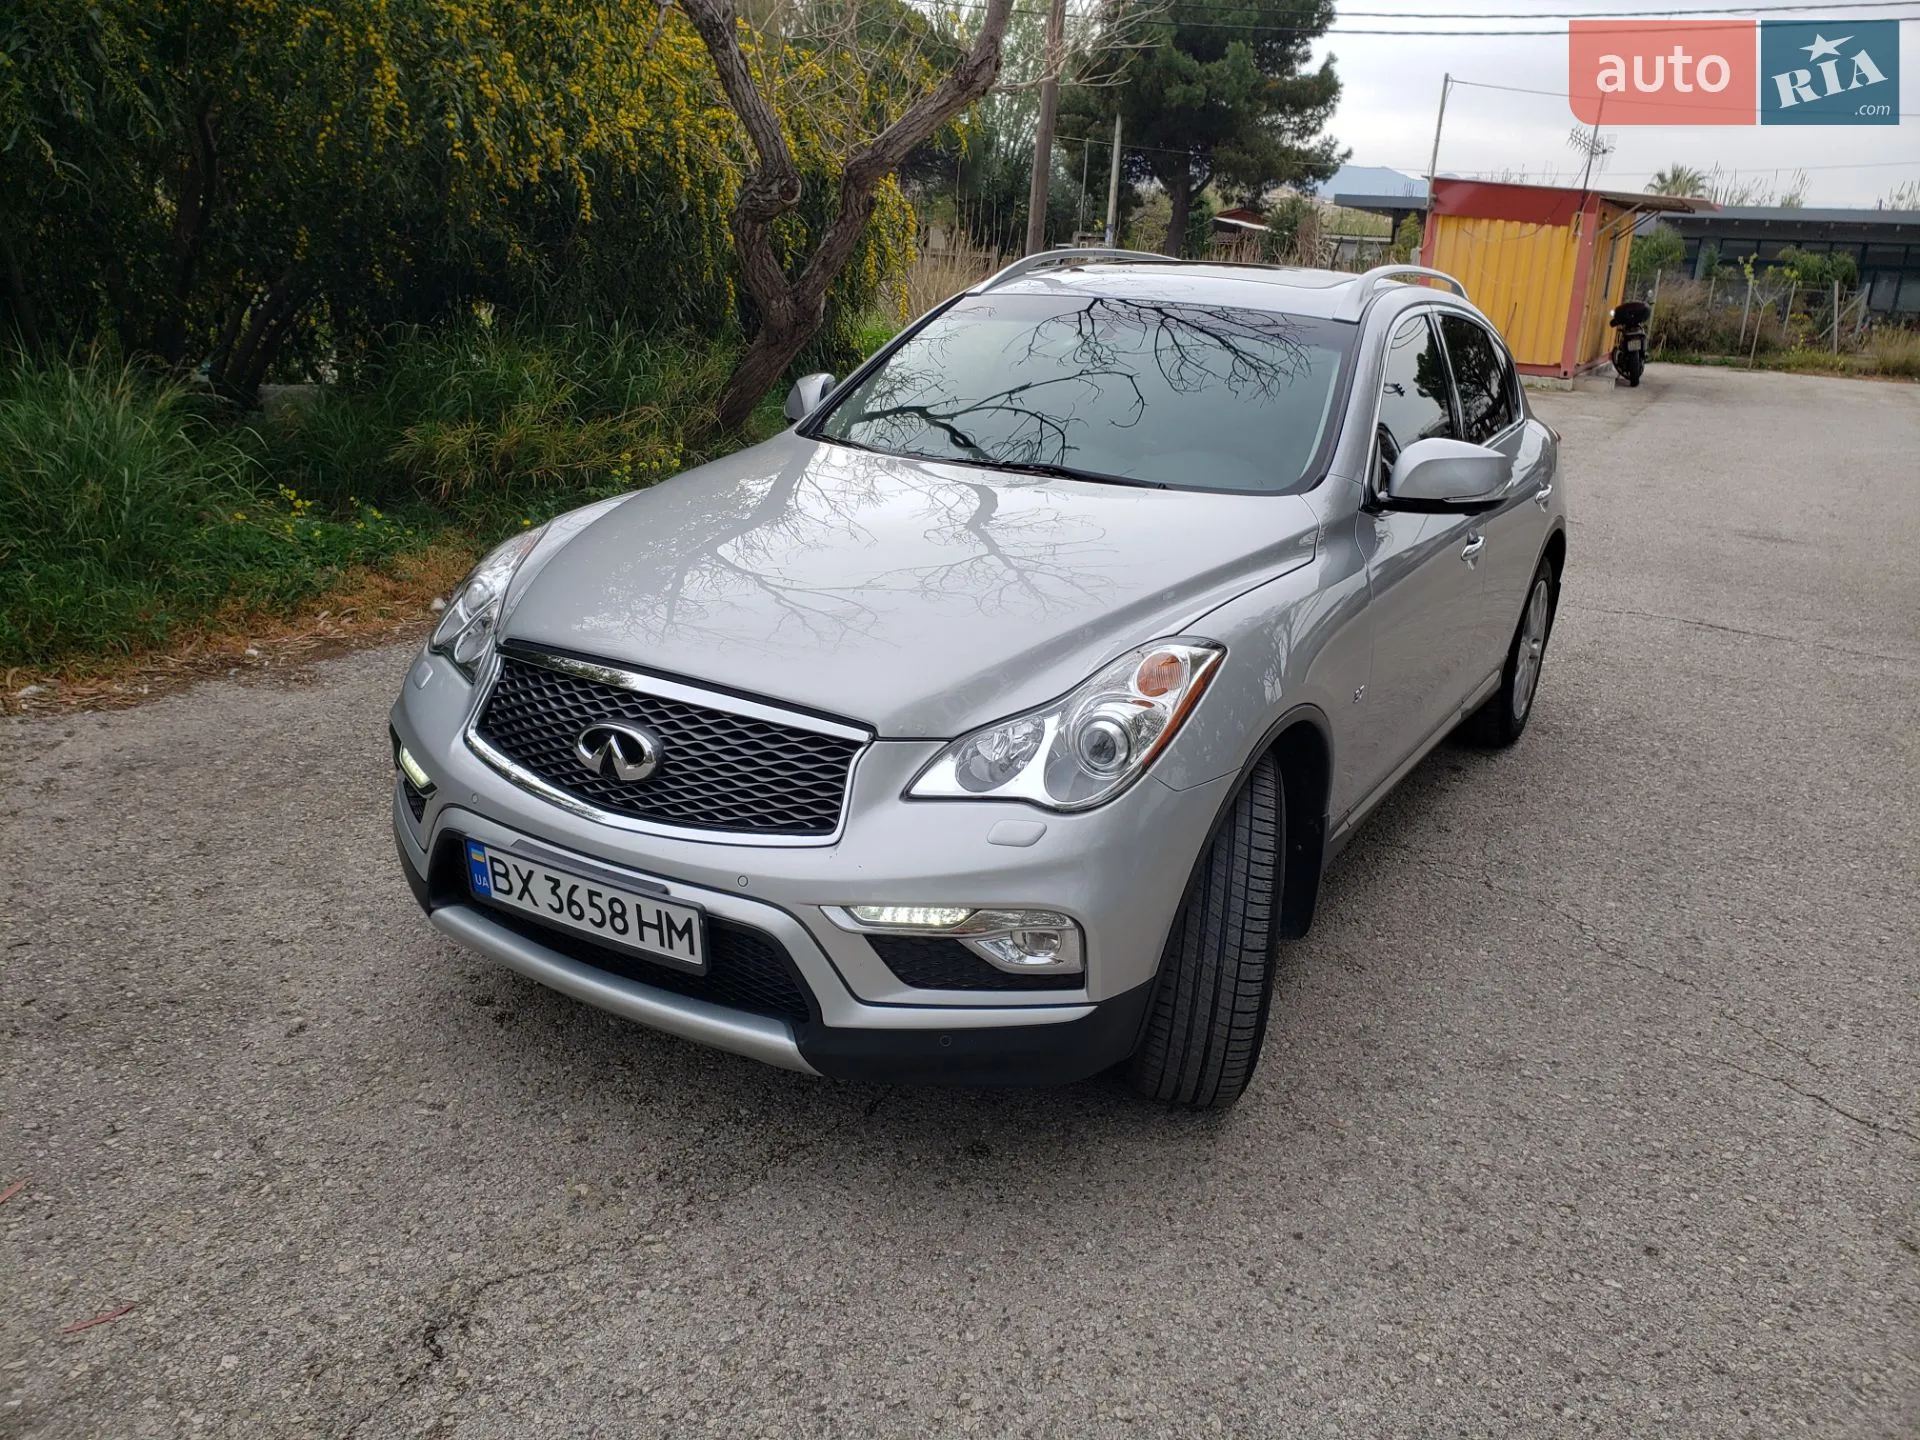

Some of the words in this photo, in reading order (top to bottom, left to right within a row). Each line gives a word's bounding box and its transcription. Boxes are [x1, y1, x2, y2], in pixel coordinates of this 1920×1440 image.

[474, 873, 489, 888] UA
[489, 855, 539, 907] BX
[544, 875, 629, 935] 3658
[636, 903, 695, 955] HM
